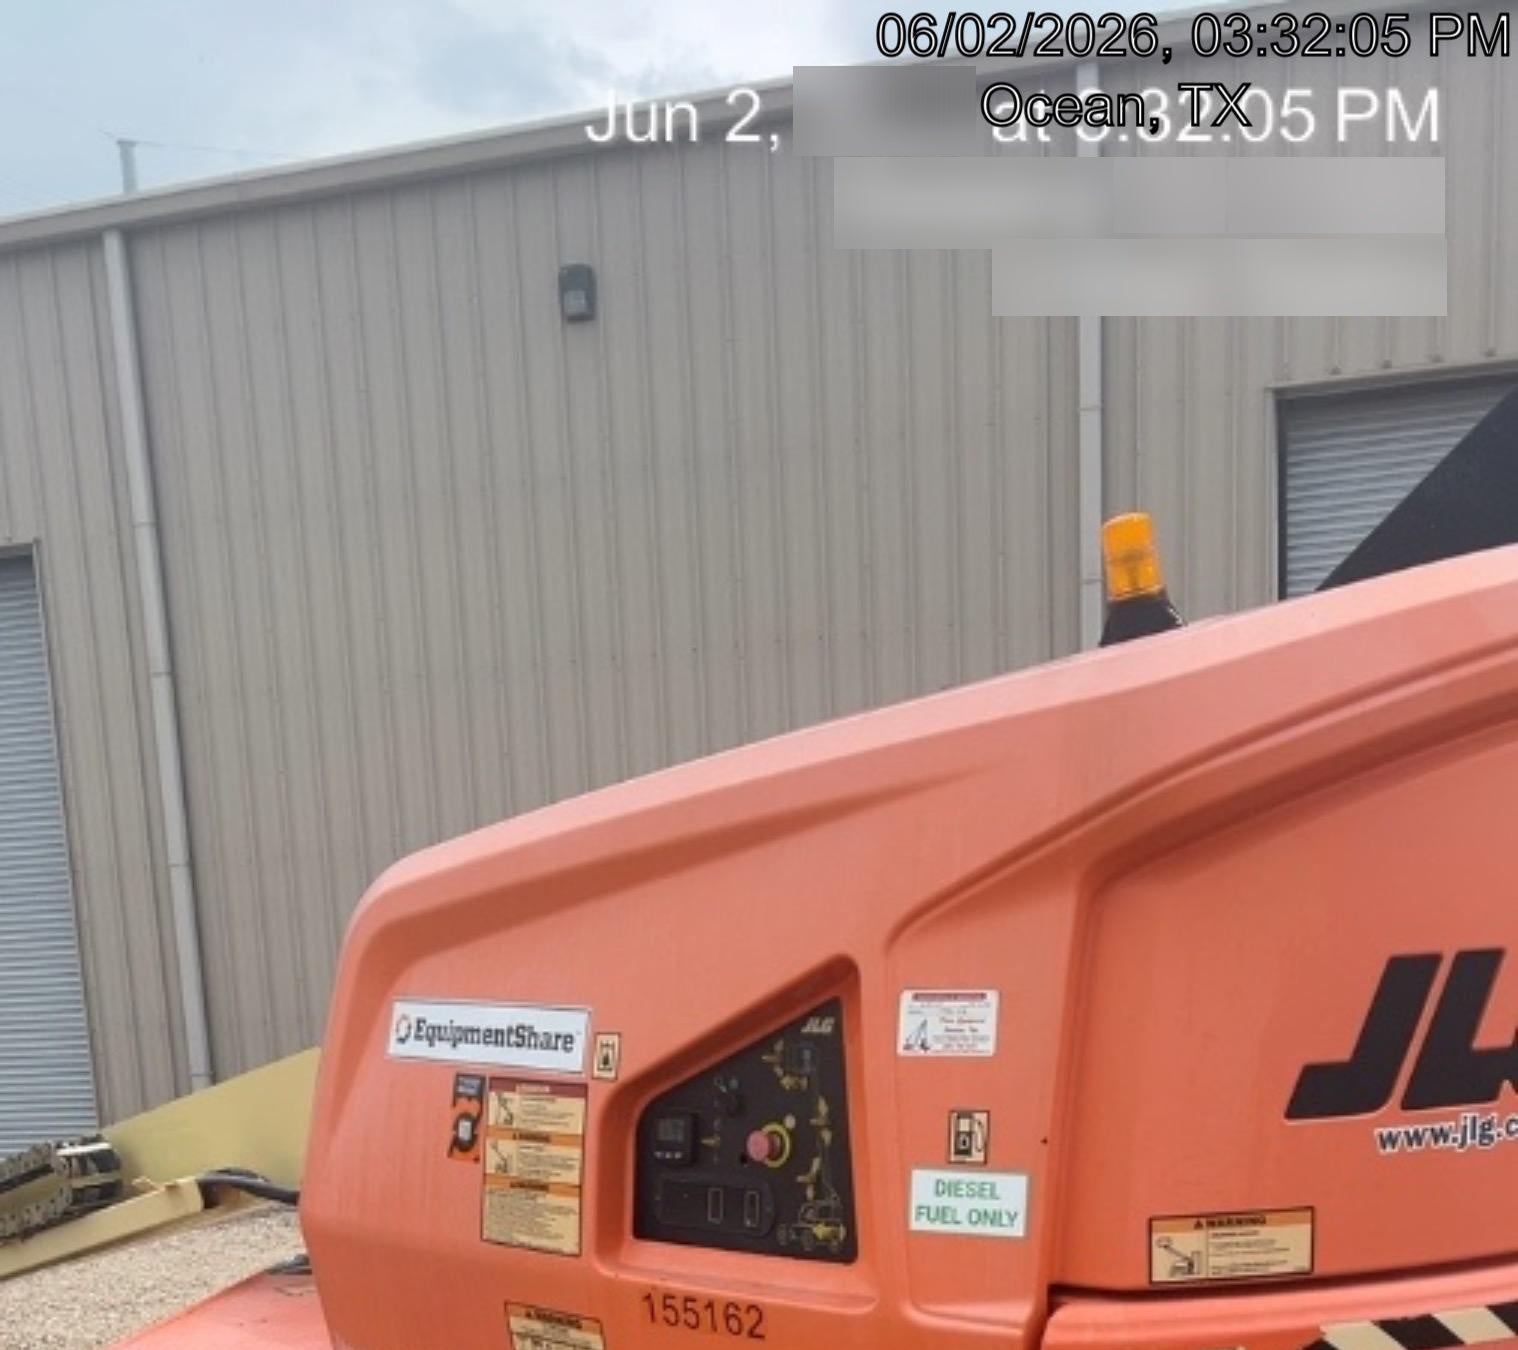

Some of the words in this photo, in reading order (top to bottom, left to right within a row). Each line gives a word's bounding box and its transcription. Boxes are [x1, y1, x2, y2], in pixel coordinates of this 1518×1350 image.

[414, 1016, 575, 1053] EquipmentShare
[1284, 946, 1518, 1120] JL
[934, 1178, 1000, 1201] DIESEL
[915, 1204, 962, 1225] FUEL
[968, 1208, 1018, 1228] ONLY
[641, 1291, 766, 1340] 155162
